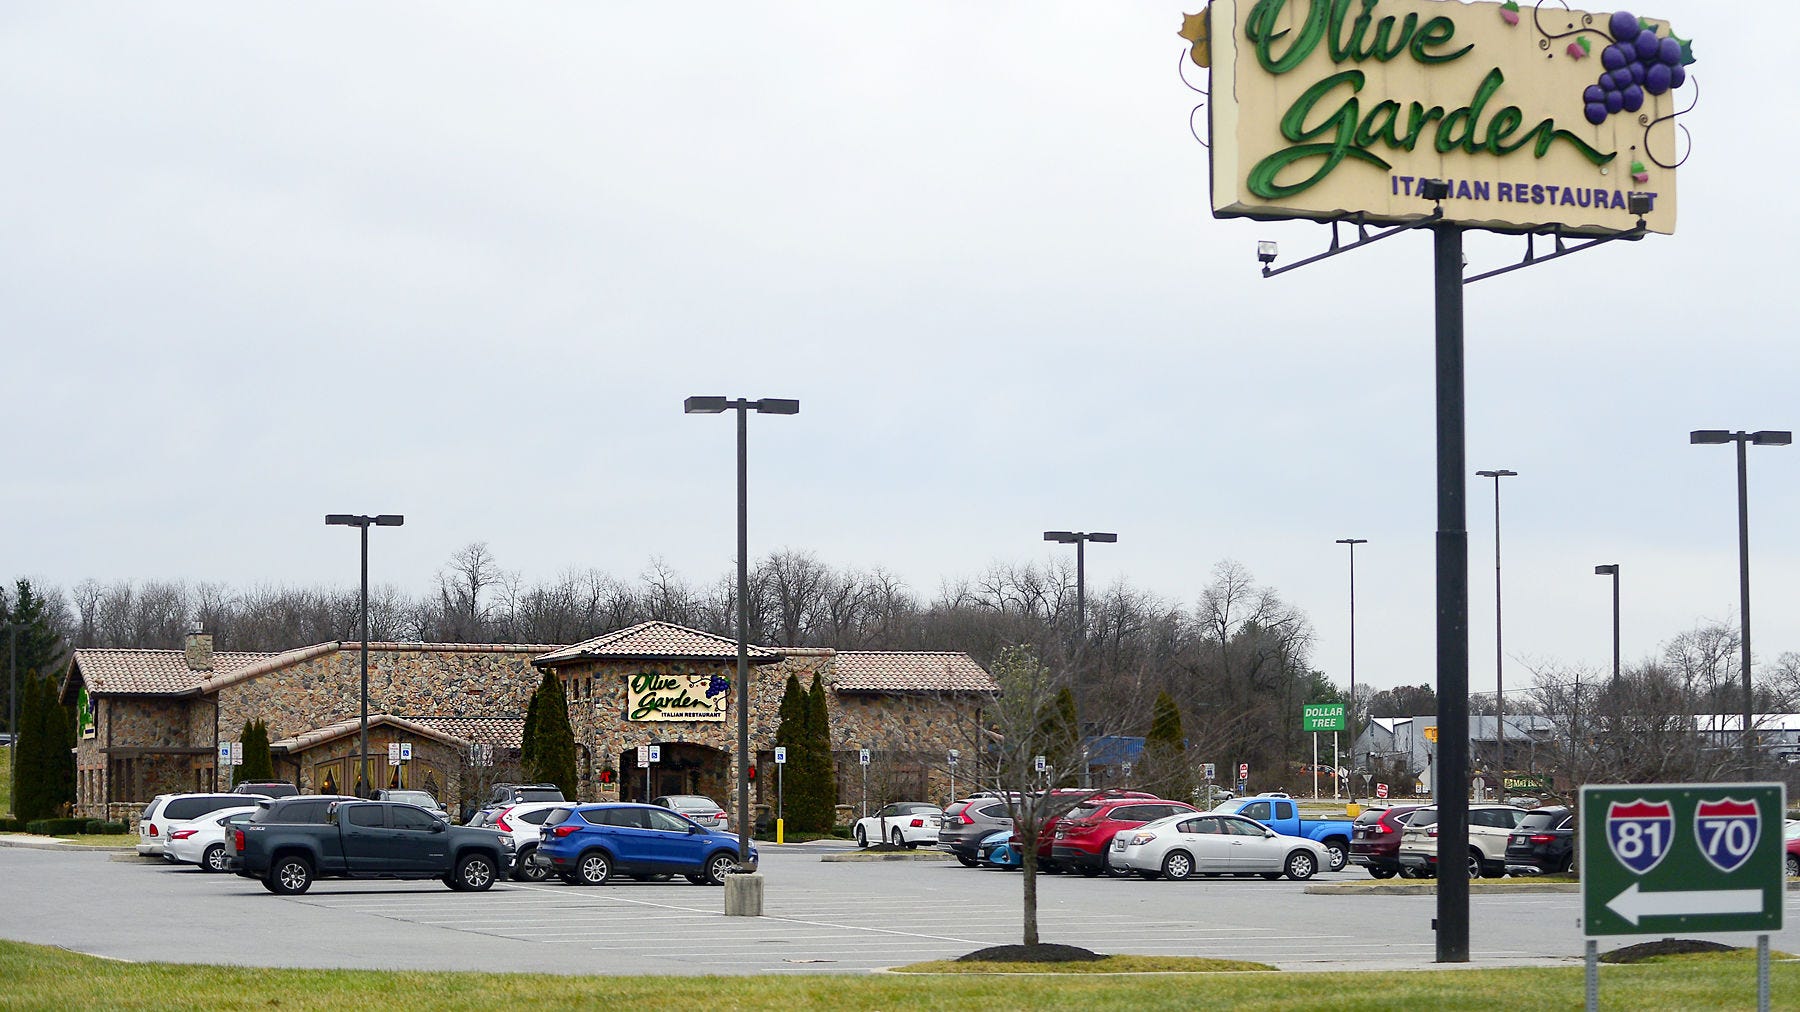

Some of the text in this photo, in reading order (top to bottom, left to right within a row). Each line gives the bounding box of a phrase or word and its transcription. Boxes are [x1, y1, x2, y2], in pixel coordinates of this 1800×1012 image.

[1245, 0, 1474, 74] Olive
[1247, 67, 1617, 199] Garden
[1392, 175, 1658, 212] ITAIAN RESTAURAT
[630, 673, 681, 694] Olive
[631, 689, 712, 719] Garden
[1305, 707, 1343, 718] DOLLAR
[1312, 718, 1337, 728] TREE
[1616, 821, 1662, 859] 81
[1704, 819, 1751, 856] 70
